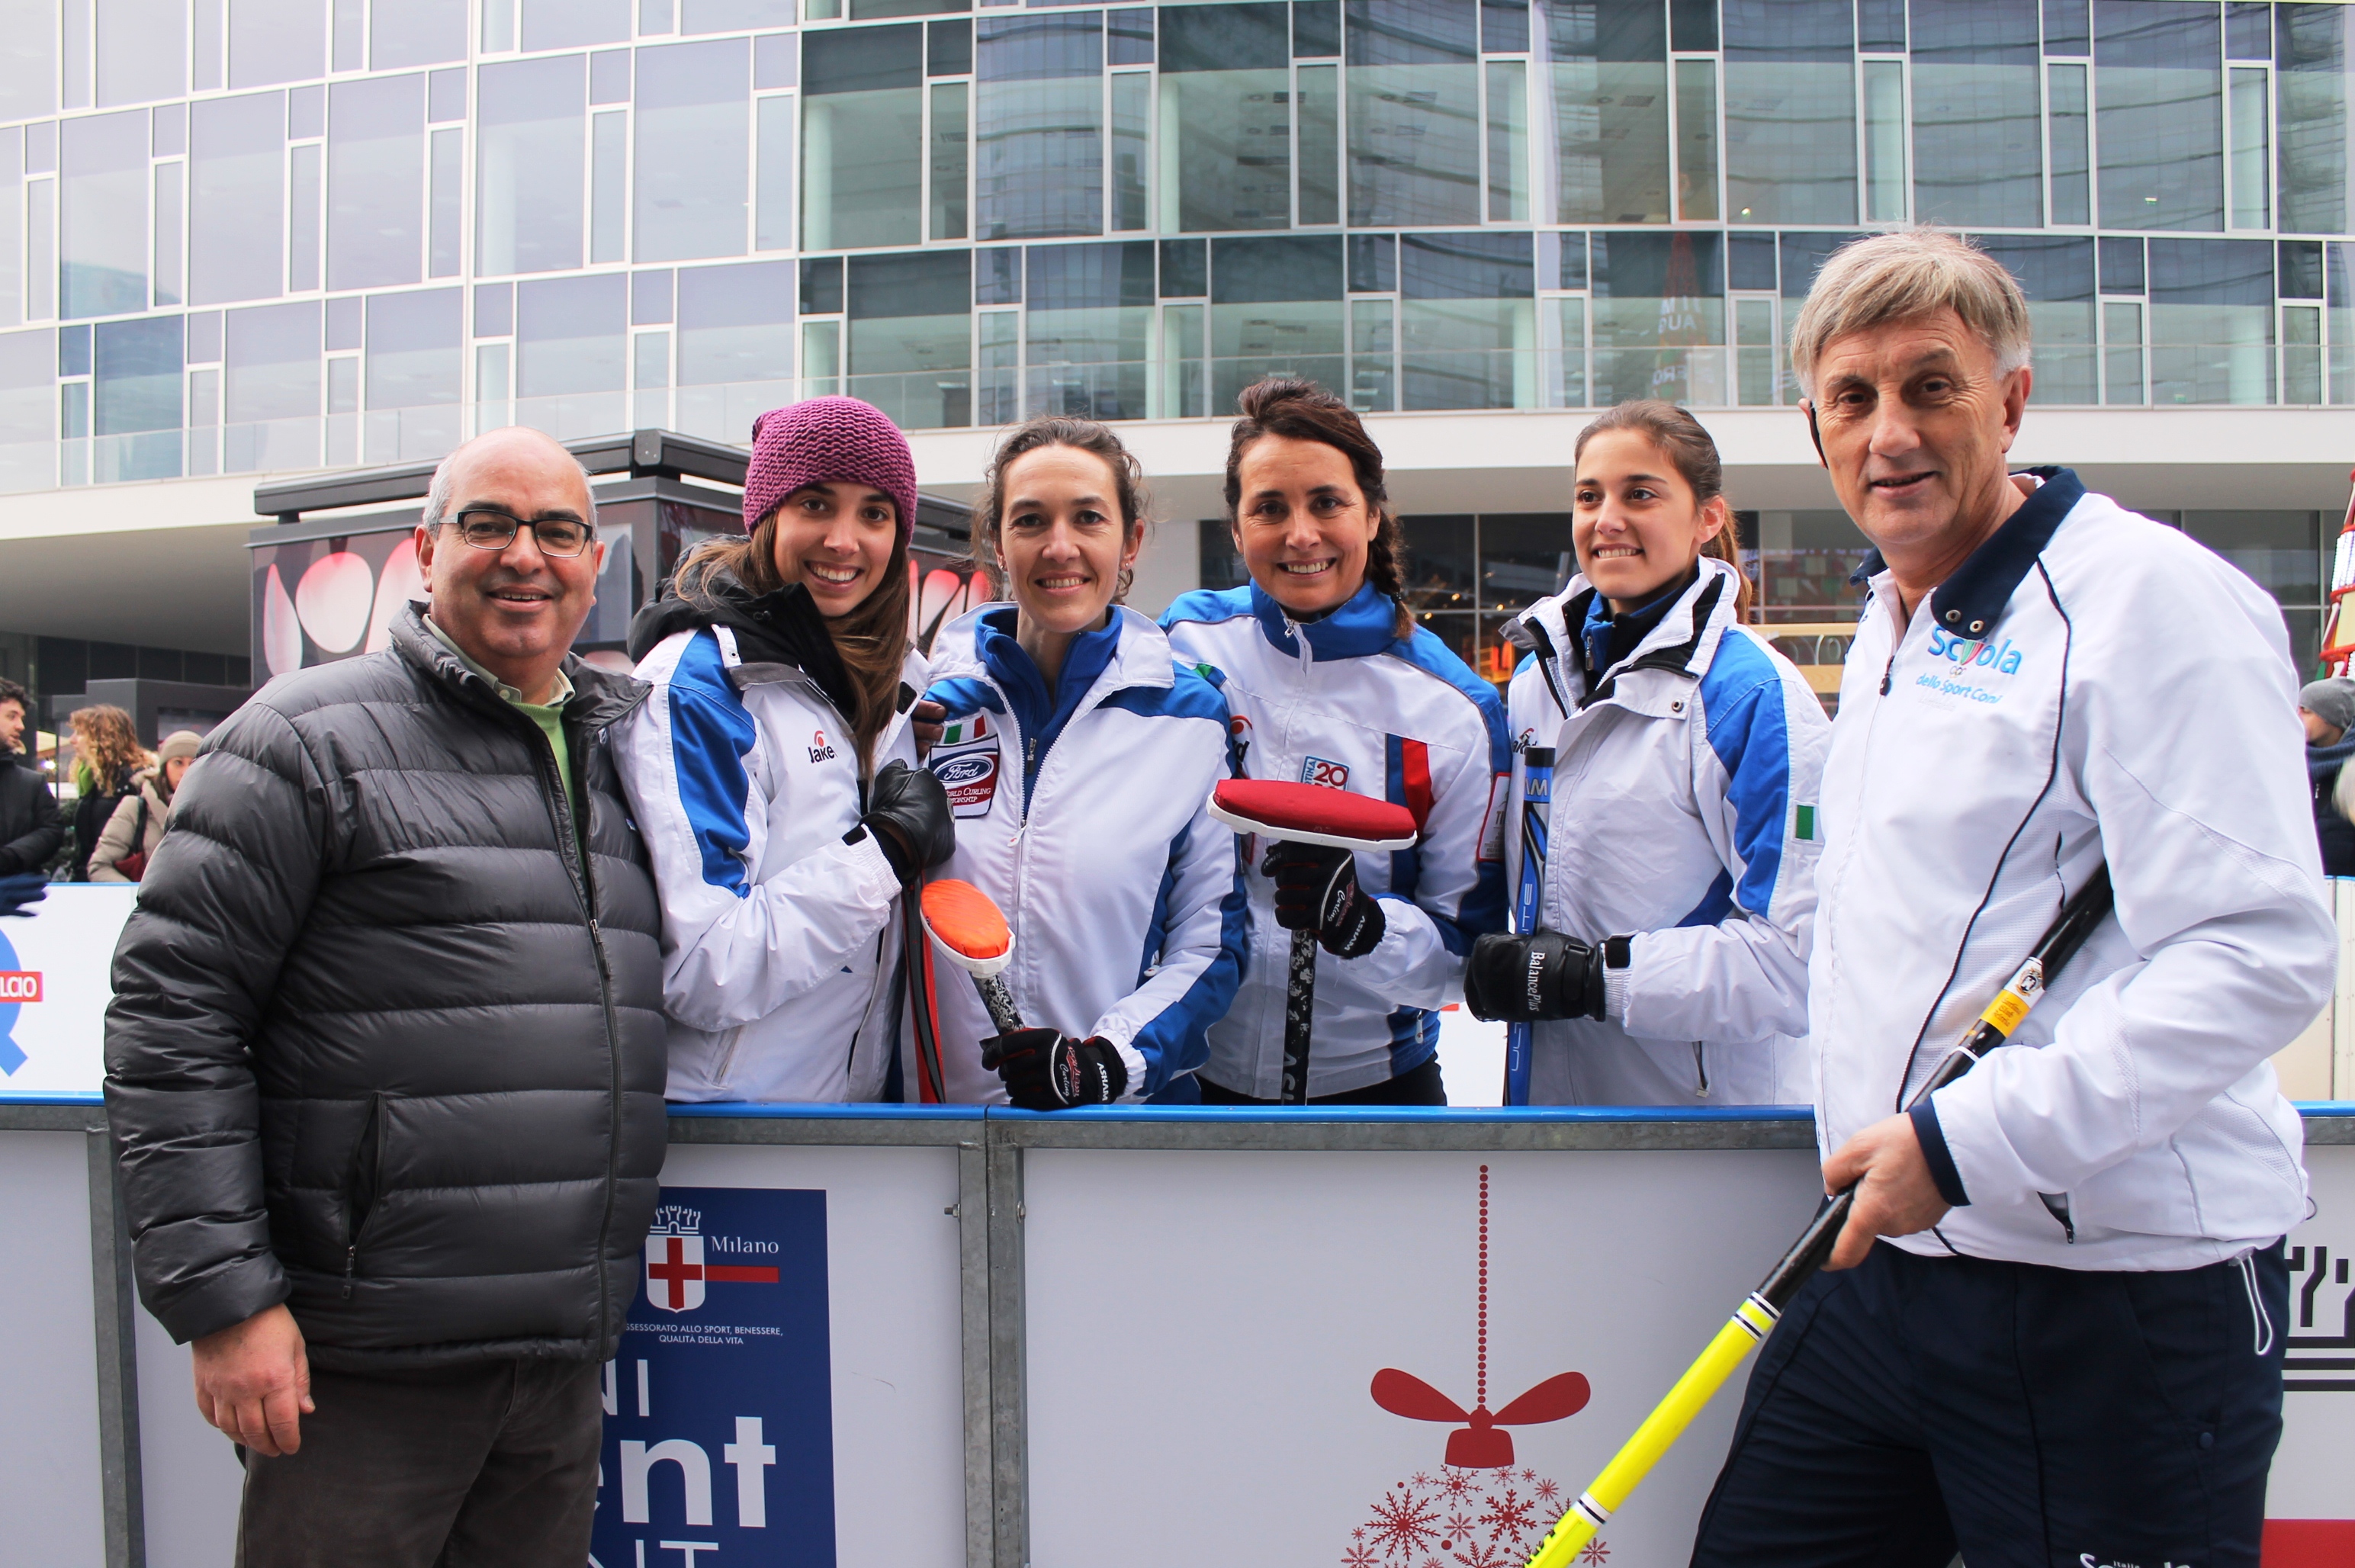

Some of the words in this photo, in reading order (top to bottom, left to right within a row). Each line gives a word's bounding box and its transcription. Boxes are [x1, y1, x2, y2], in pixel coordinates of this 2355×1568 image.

[1916, 673, 1941, 689] dello
[1939, 679, 1973, 698] Sport
[1971, 688, 2003, 704] Coni
[944, 763, 980, 780] Ford
[1313, 762, 1348, 786] 20
[1327, 890, 1346, 922] Curling
[1345, 915, 1366, 951] ASHAM
[1059, 1063, 1070, 1097] Curling
[1097, 1062, 1109, 1101] ASHAM
[711, 1235, 779, 1254] Milano
[625, 1323, 678, 1333] SSESSORATO
[704, 1325, 732, 1335] SPORT,
[734, 1326, 783, 1336] BENESSERE,
[659, 1335, 696, 1343] QUALITÀ
[595, 1416, 776, 1528] nt
